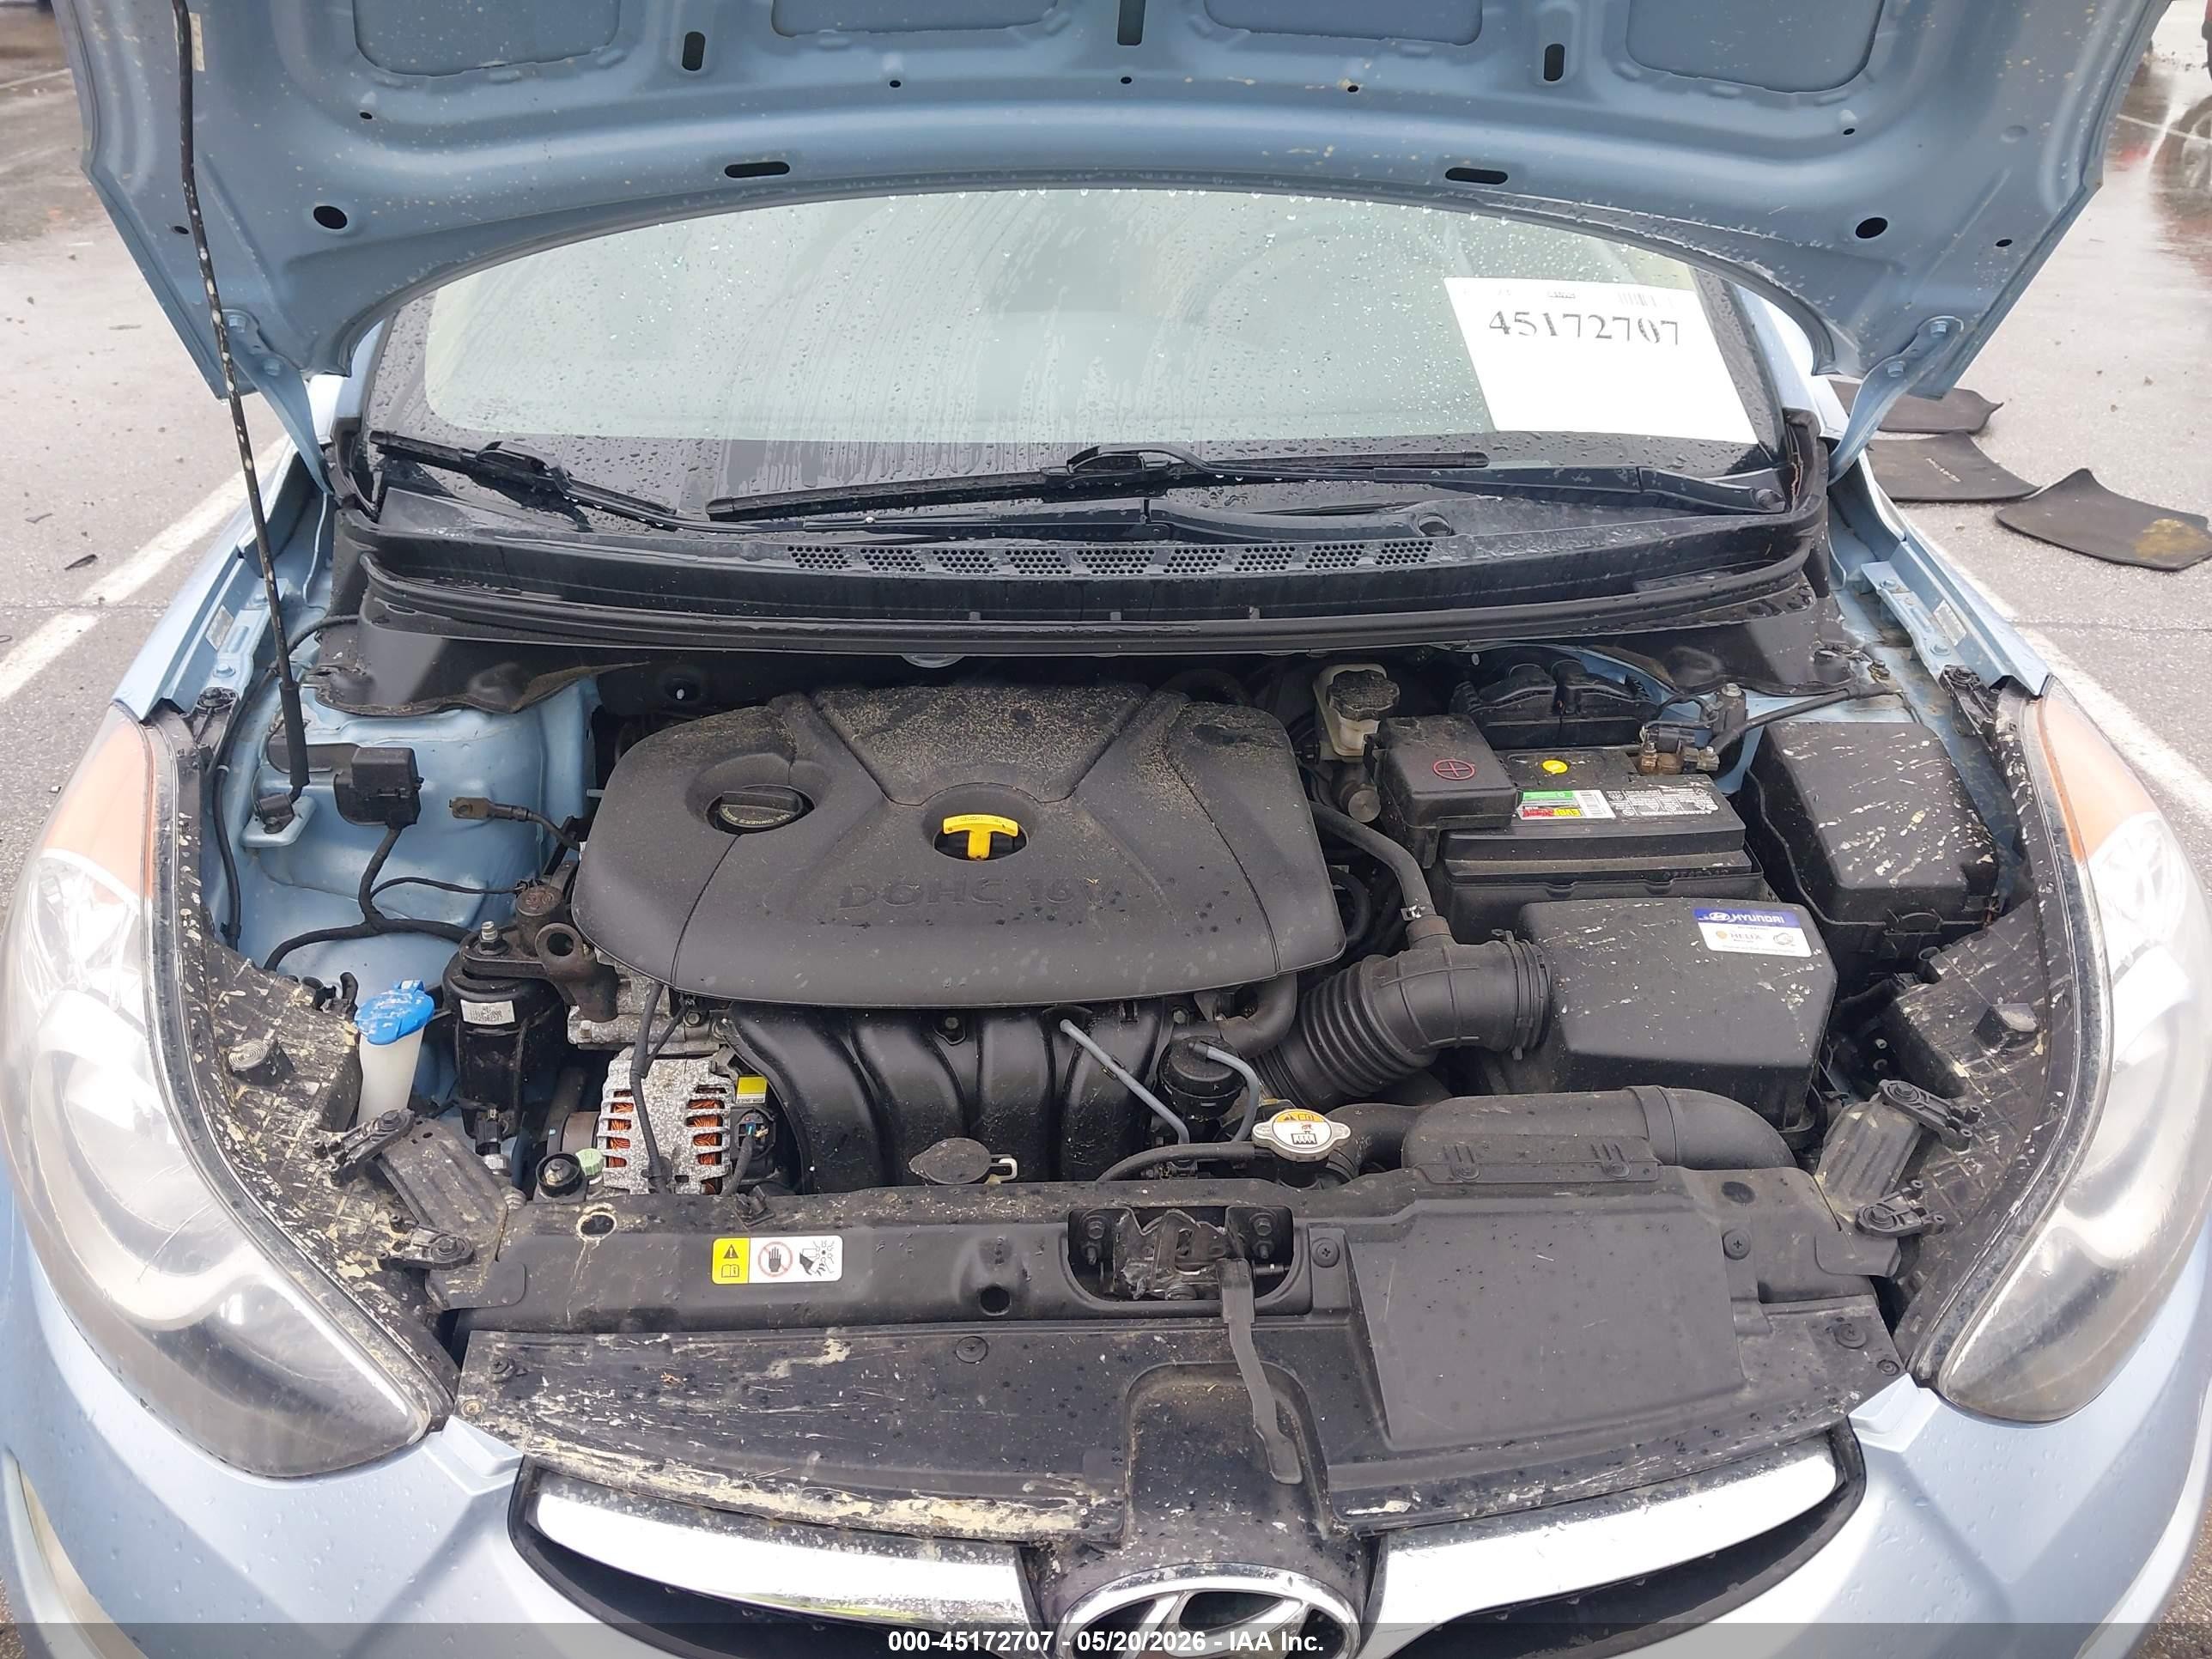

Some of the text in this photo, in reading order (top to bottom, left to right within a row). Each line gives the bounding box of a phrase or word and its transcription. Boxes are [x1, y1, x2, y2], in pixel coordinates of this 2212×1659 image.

[1488, 309, 1680, 346] 45172707
[838, 876, 1006, 910] DOHC
[1731, 913, 1785, 924] HYUNDAI
